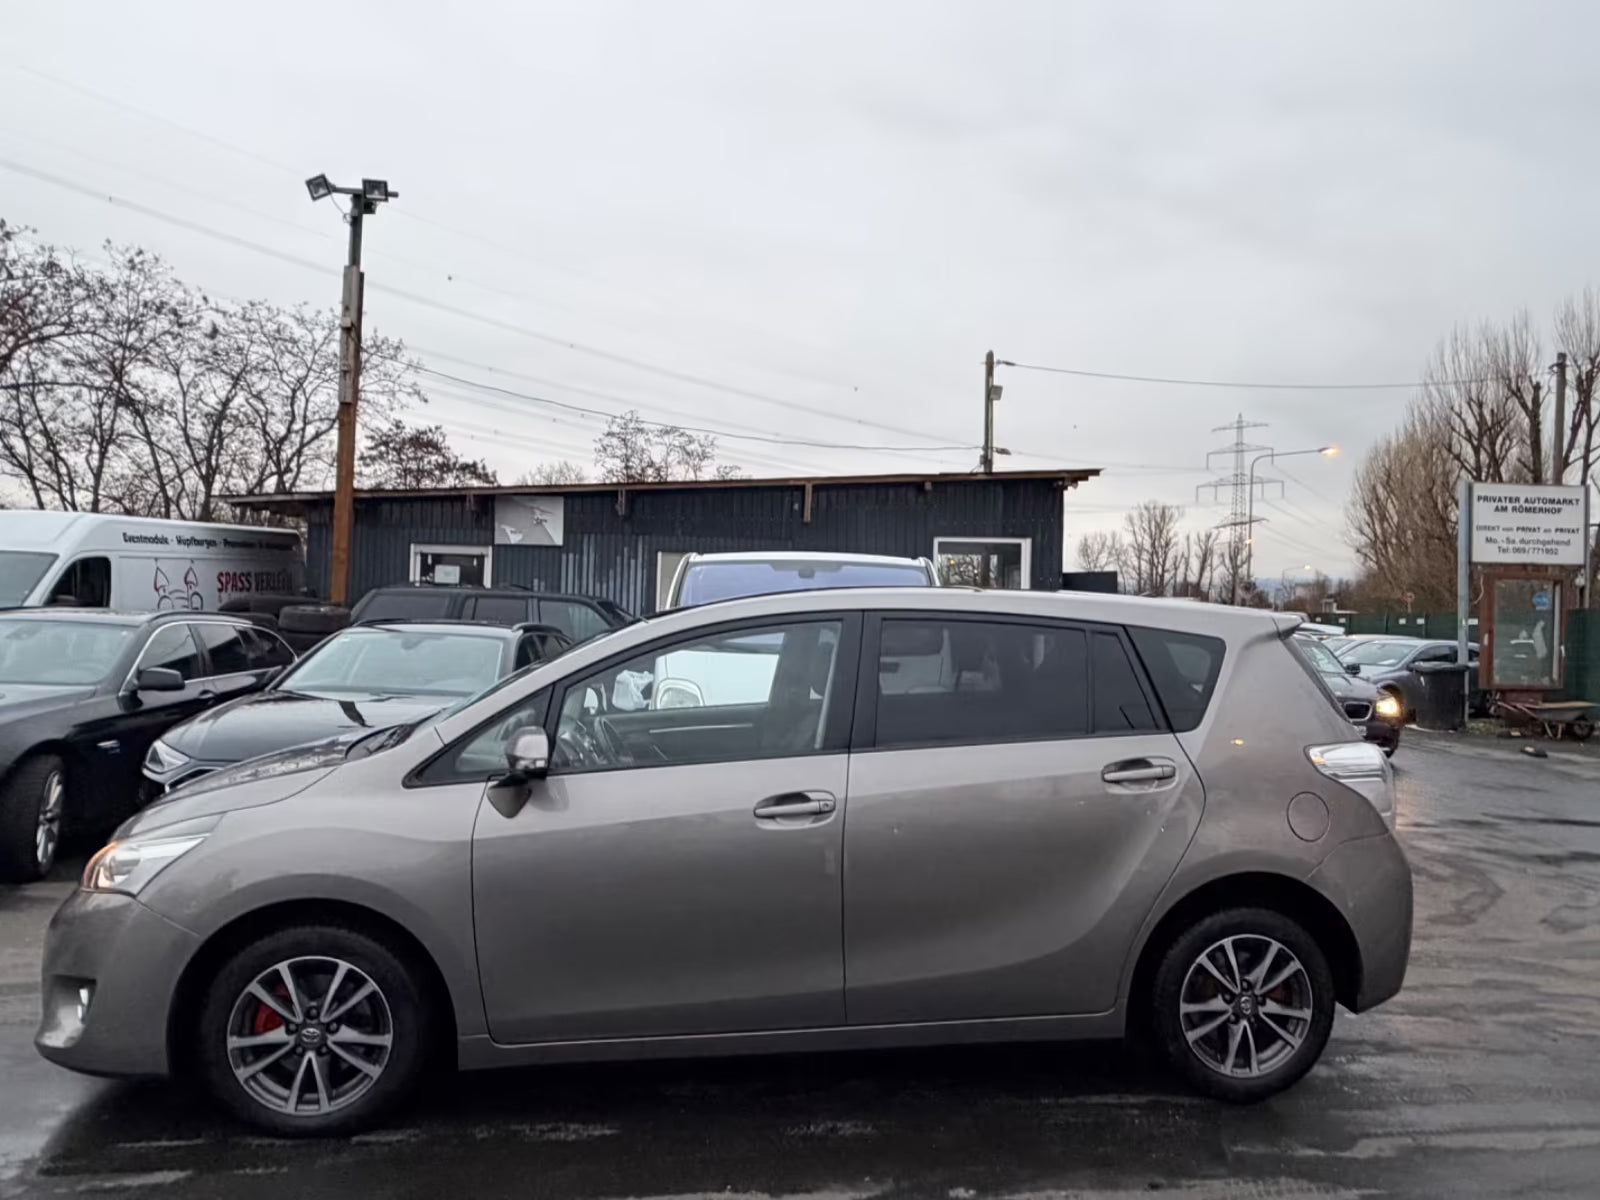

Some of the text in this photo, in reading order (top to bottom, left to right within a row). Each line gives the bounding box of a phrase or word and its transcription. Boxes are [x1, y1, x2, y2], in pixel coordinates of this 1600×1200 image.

[1477, 495, 1580, 505] PRIVATER AUTOMARKT
[1494, 505, 1563, 515] AM RÖMERHOF
[1519, 537, 1571, 547] durchgehend
[217, 571, 252, 592] SPASS
